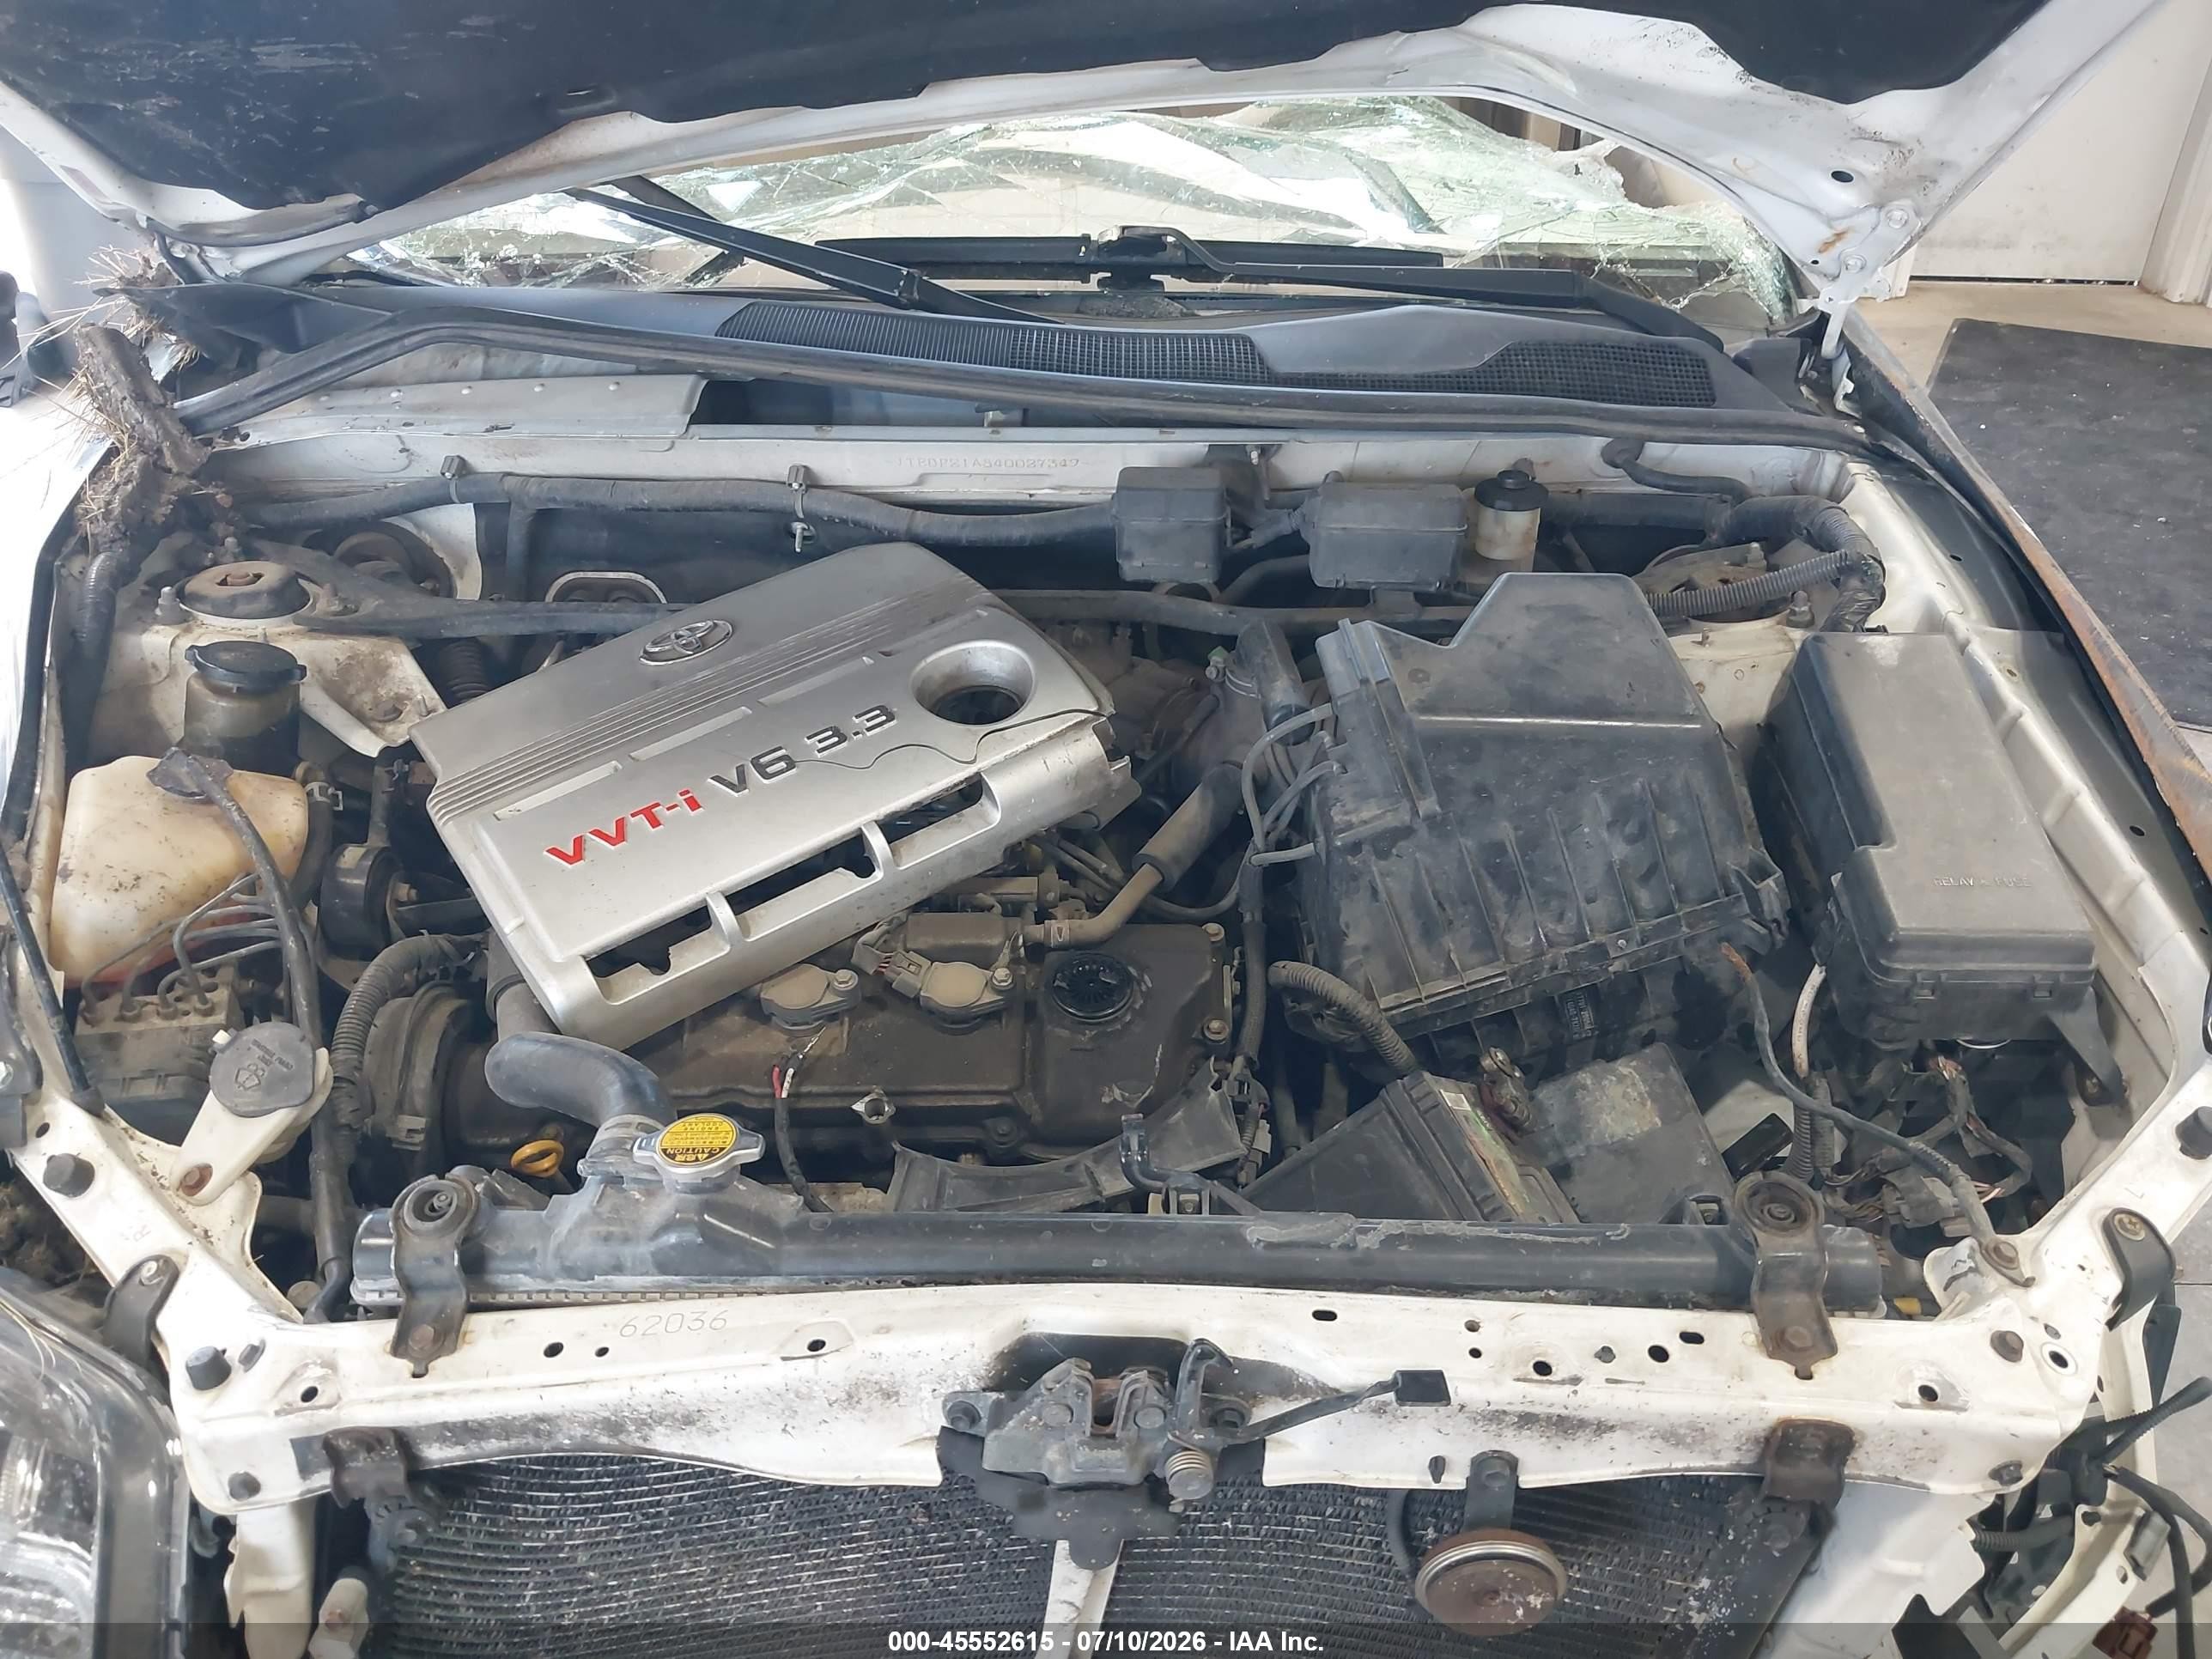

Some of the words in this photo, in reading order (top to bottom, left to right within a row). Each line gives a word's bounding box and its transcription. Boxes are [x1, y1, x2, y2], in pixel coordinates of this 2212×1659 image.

[544, 789, 705, 866] VVT-i
[708, 745, 797, 796] V6
[805, 704, 896, 757] 3.3
[1933, 877, 1973, 886] RELAY
[1995, 878, 2032, 887] FUSE
[619, 1310, 728, 1338] 62036
